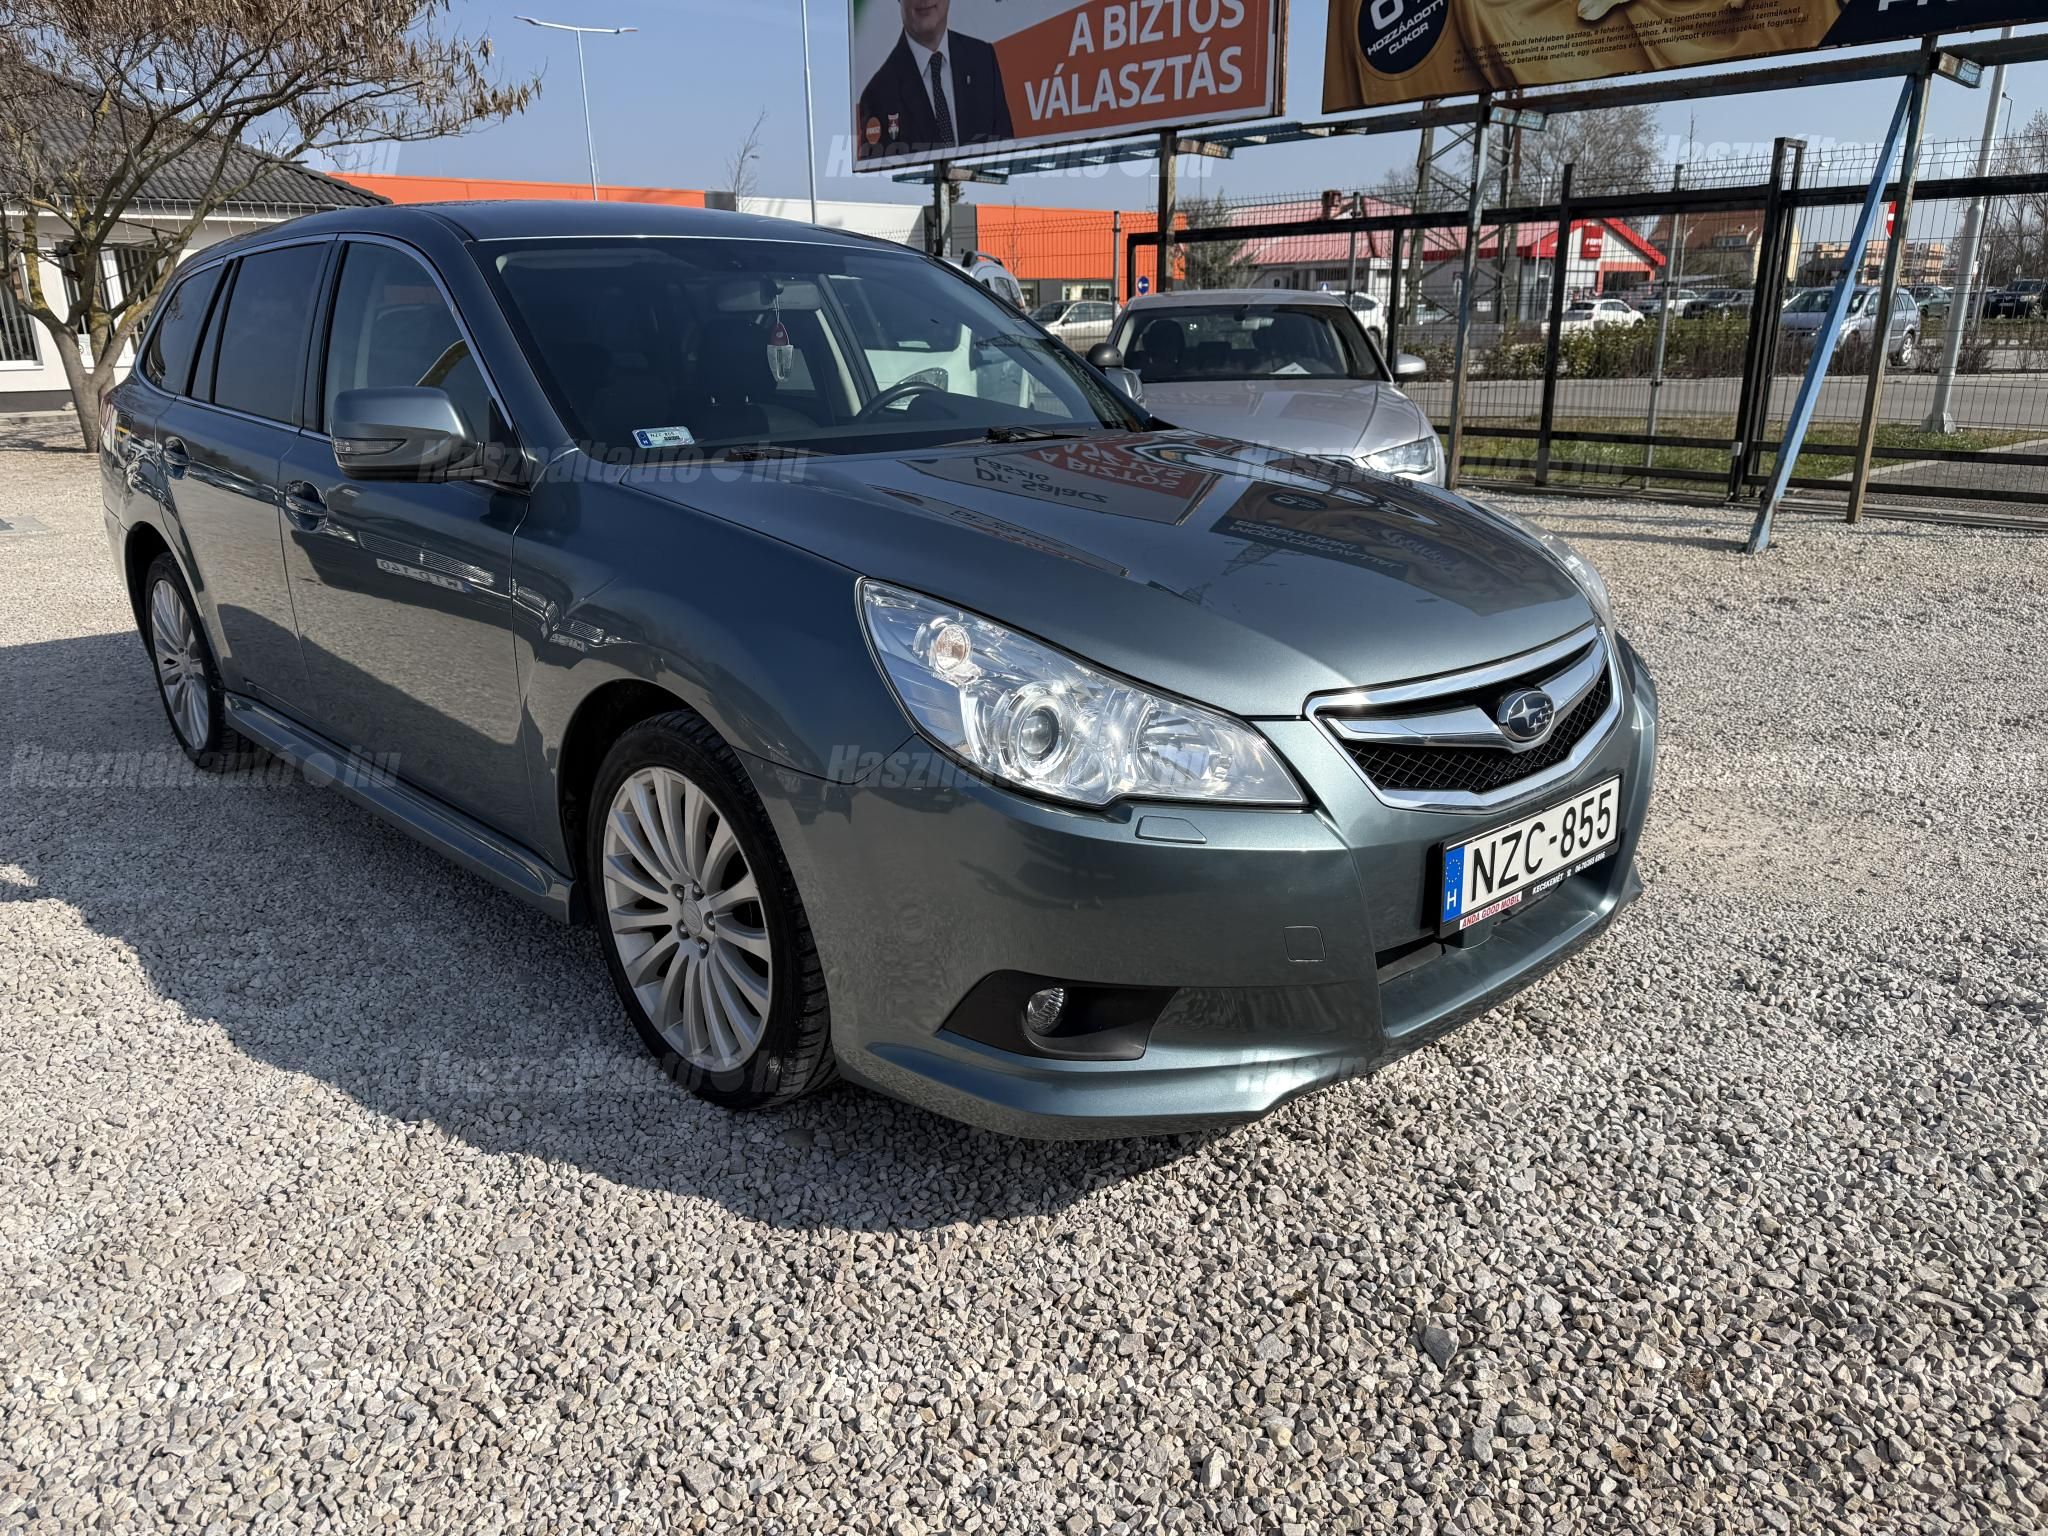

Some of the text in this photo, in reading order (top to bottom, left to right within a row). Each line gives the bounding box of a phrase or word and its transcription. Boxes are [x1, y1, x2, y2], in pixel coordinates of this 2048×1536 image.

[1068, 0, 1245, 57] A BIZTOS
[1388, 21, 1429, 55] CUKOR
[1511, 39, 1527, 47] Rudi
[1511, 46, 1539, 55] valamint
[1577, 49, 1590, 57] egy
[1024, 37, 1243, 122] VÁLASZTÁS
[1471, 788, 1612, 902] NZC-855
[1446, 888, 1457, 911] H
[1462, 911, 1480, 928] ANDA
[1481, 902, 1500, 919] GOOD
[1500, 894, 1520, 910] MOBIL
[1532, 872, 1564, 895] KECSKEMÉT
